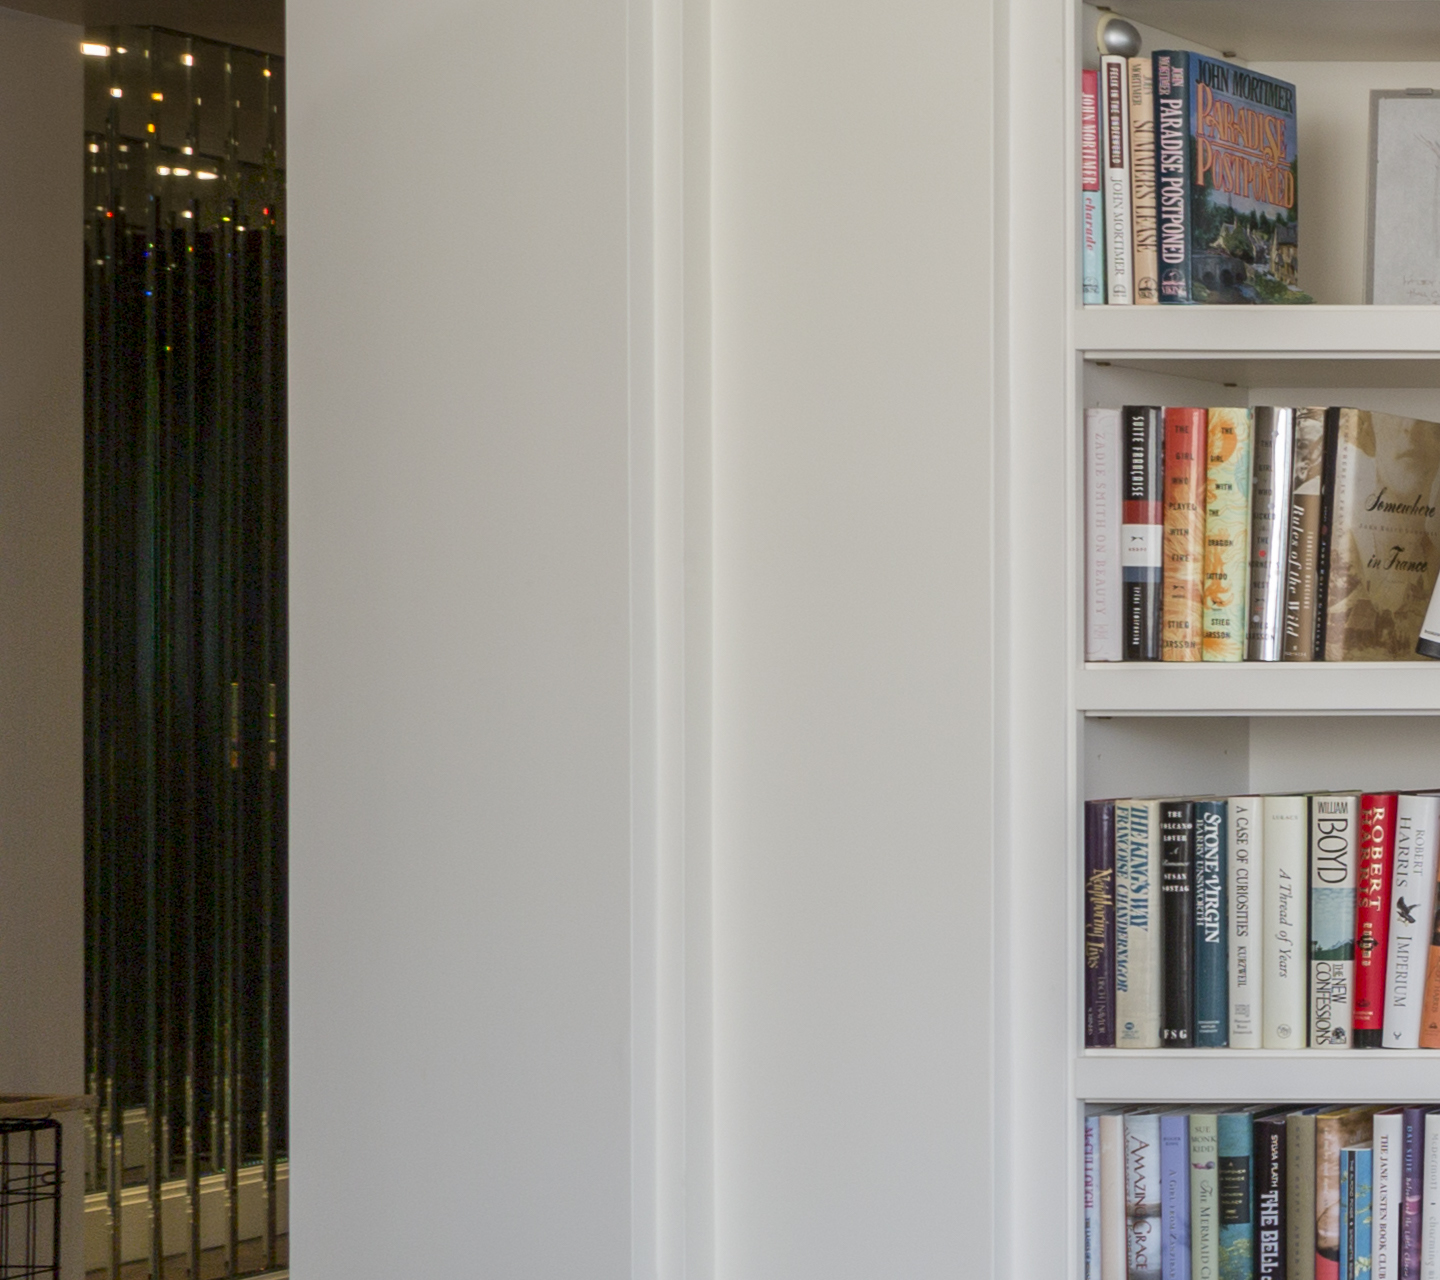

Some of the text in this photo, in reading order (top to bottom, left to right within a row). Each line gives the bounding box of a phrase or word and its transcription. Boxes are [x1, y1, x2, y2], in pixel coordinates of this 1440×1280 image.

[1161, 99, 1184, 263] PARADISE POSTPONED
[1204, 812, 1220, 943] STONE VIRGIN
[1318, 818, 1348, 883] BOYD
[1370, 807, 1384, 911] ROBERT
[1276, 884, 1291, 977] Thread of Years
[1316, 962, 1332, 1045] CONFESSIONS
[1131, 1136, 1151, 1270] AMAZING GRACE
[1260, 1191, 1278, 1226] THE
[1260, 1230, 1278, 1274] BELL
